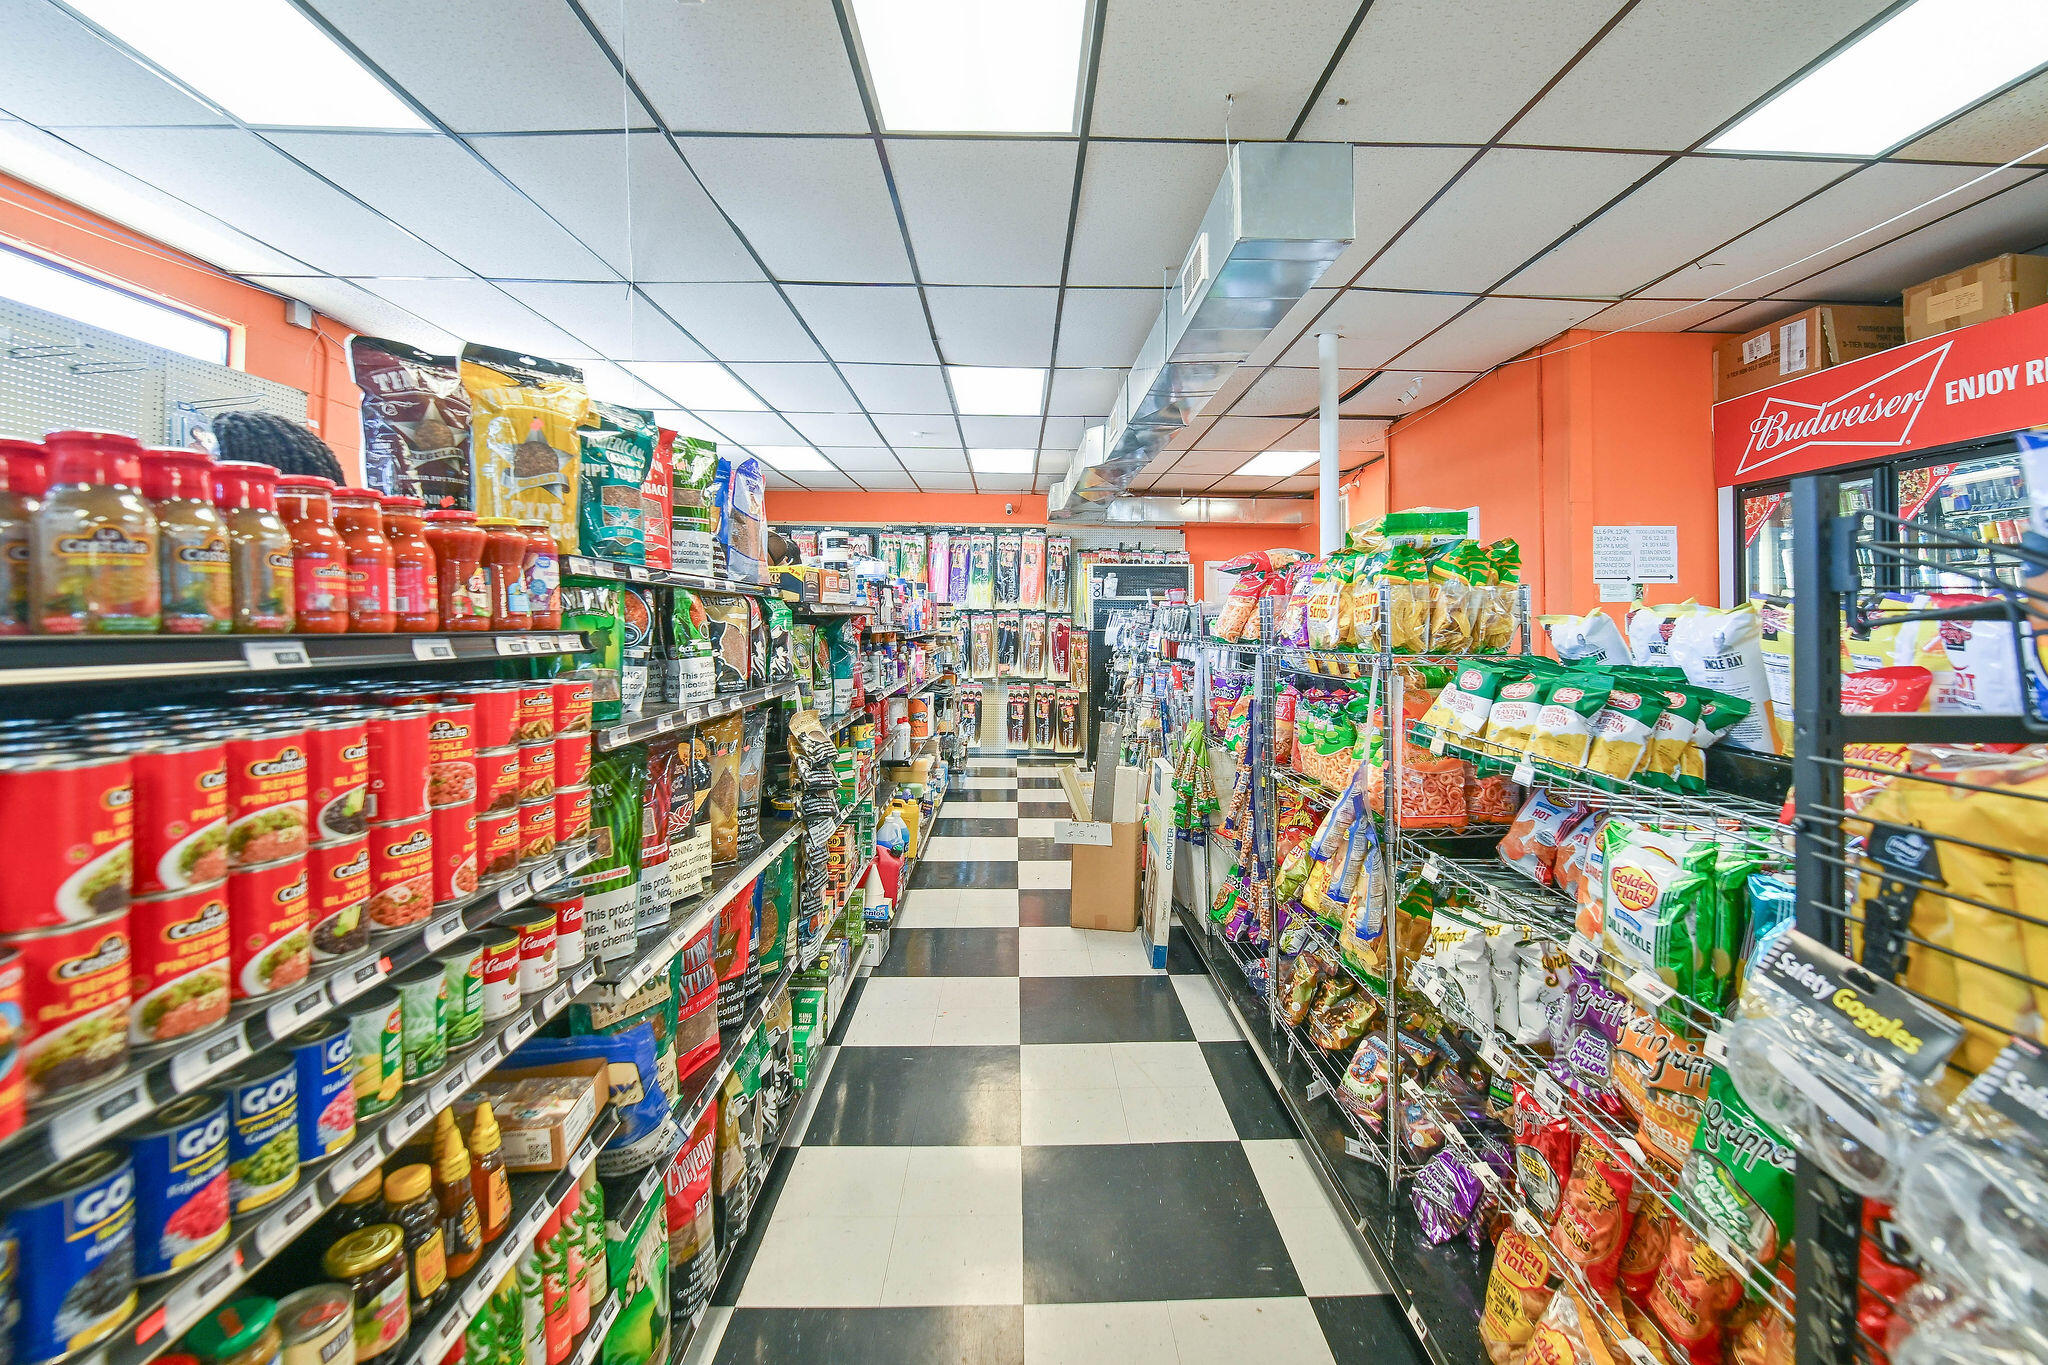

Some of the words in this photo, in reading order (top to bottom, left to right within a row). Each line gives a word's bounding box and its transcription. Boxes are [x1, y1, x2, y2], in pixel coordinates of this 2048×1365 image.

[1945, 365, 2019, 405] ENJOY
[1750, 390, 1927, 452] Budweiser
[511, 502, 563, 520] PIPE
[1648, 645, 1667, 655] UNCLE
[1727, 655, 1744, 668] RAY
[682, 672, 699, 680] This
[1532, 809, 1551, 821] HOT
[1165, 827, 1174, 870] COMPUTER
[1612, 869, 1658, 897] Golden
[1616, 884, 1650, 906] Flake
[585, 908, 605, 923] This
[1623, 926, 1651, 954] PICKLE
[1775, 952, 1838, 1001] Safety
[1833, 988, 1924, 1055] Goggles
[1575, 1037, 1609, 1062] Maui
[1580, 1030, 1606, 1048] Sweet
[1569, 1050, 1609, 1077] Onion
[1657, 1092, 1701, 1125] HOT
[1418, 1170, 1443, 1197] Onion
[1500, 1245, 1537, 1287] Flake
